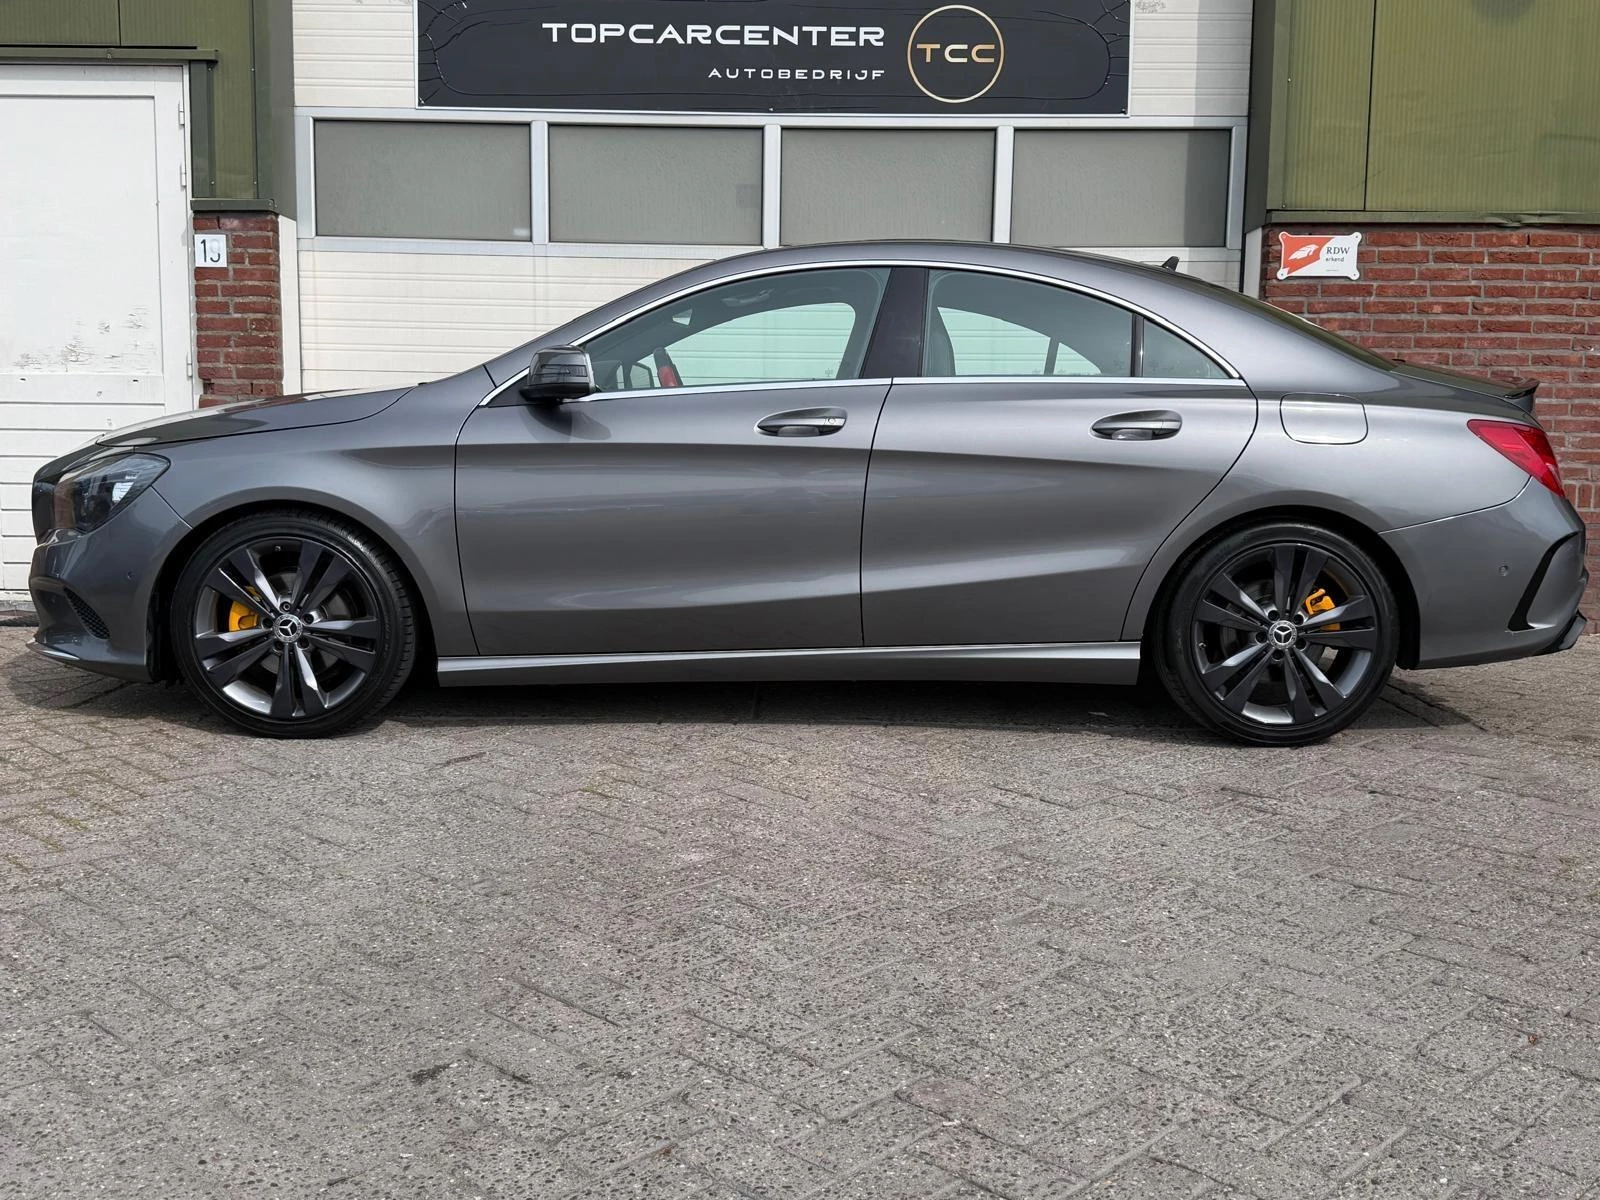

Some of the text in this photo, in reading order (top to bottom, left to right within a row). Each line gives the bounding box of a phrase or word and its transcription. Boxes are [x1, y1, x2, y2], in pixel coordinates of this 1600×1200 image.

[542, 23, 885, 47] TOPCARCENTER
[916, 43, 995, 63] TCC
[708, 68, 885, 81] AUTOBEDRIJF
[1326, 246, 1350, 255] RDW
